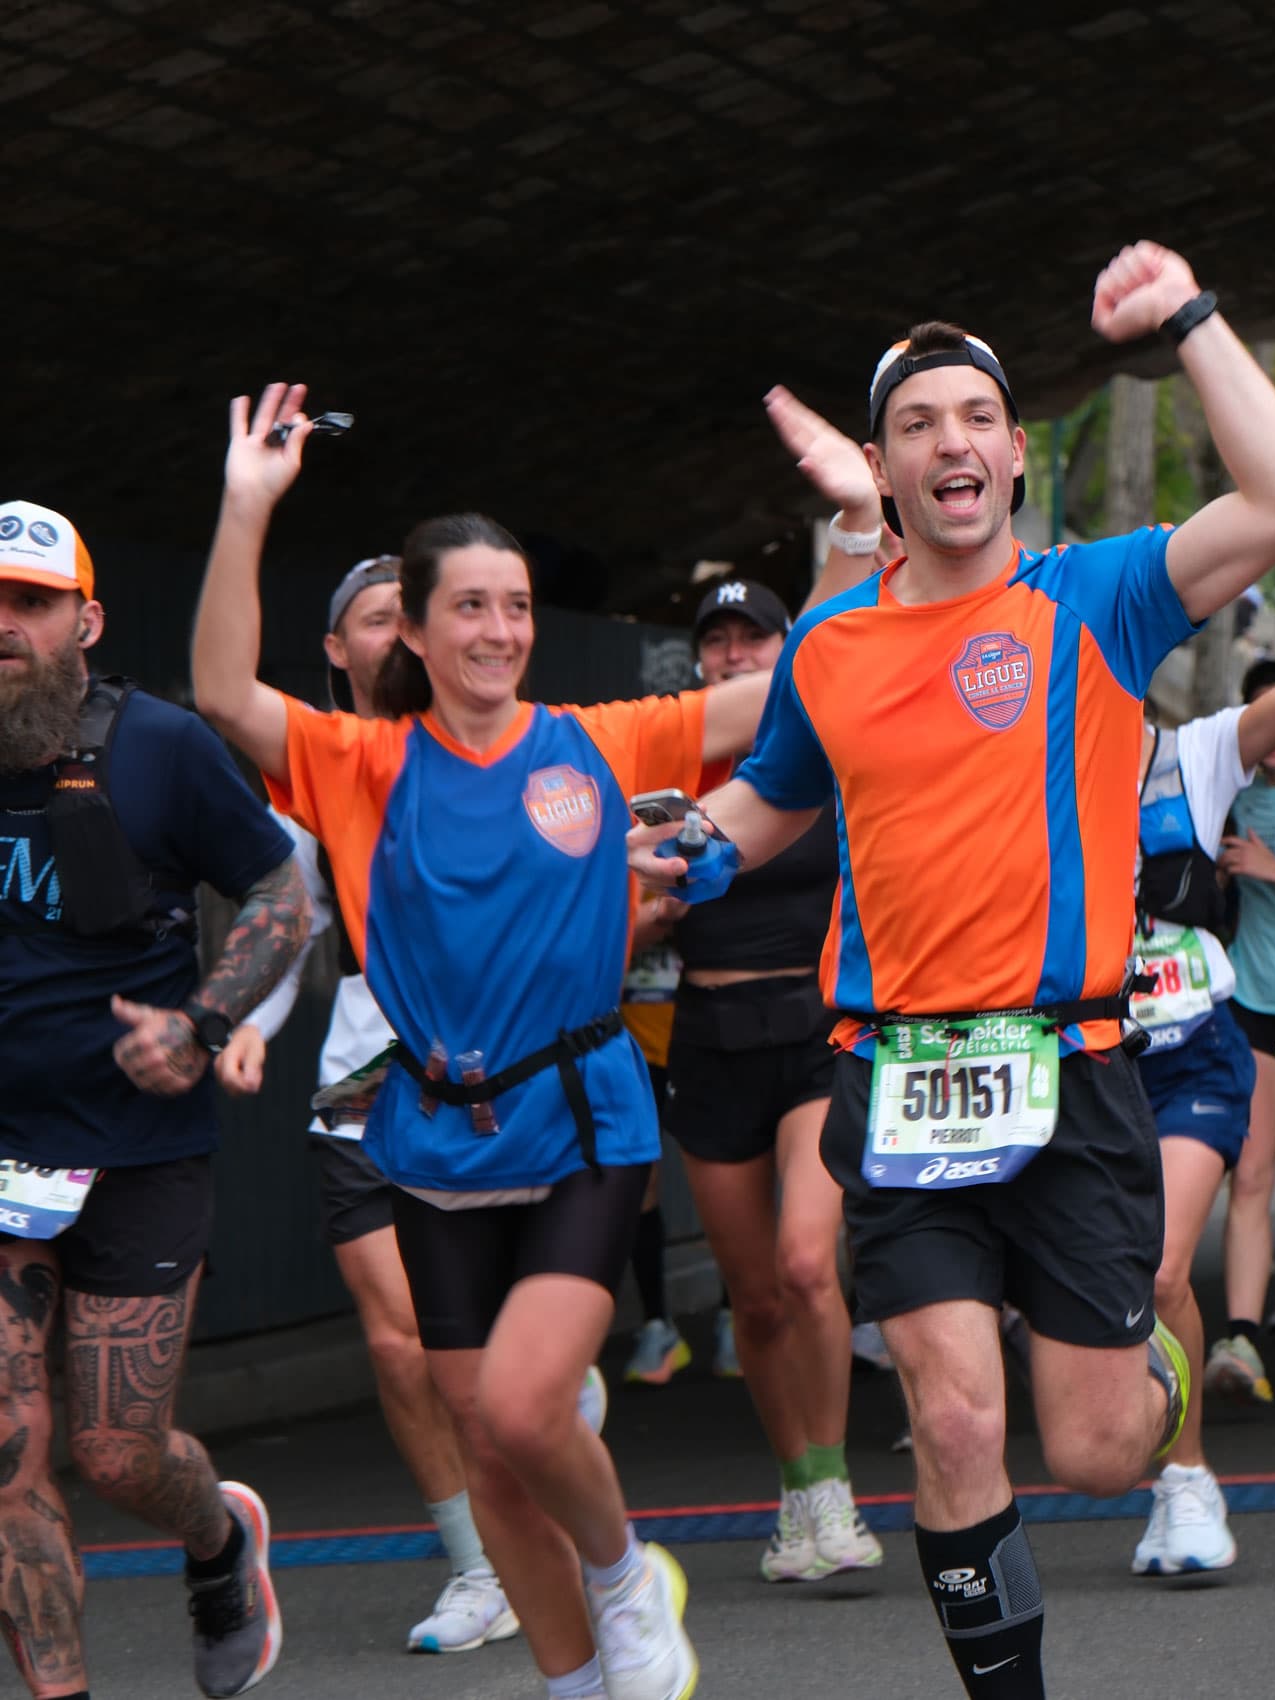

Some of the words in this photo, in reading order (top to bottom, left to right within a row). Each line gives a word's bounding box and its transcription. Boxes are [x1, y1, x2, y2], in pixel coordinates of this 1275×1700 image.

[963, 661, 1026, 692] LIGUE
[966, 1039, 1031, 1054] Electric
[902, 1063, 1013, 1122] 50151
[943, 1157, 1001, 1180] asics
